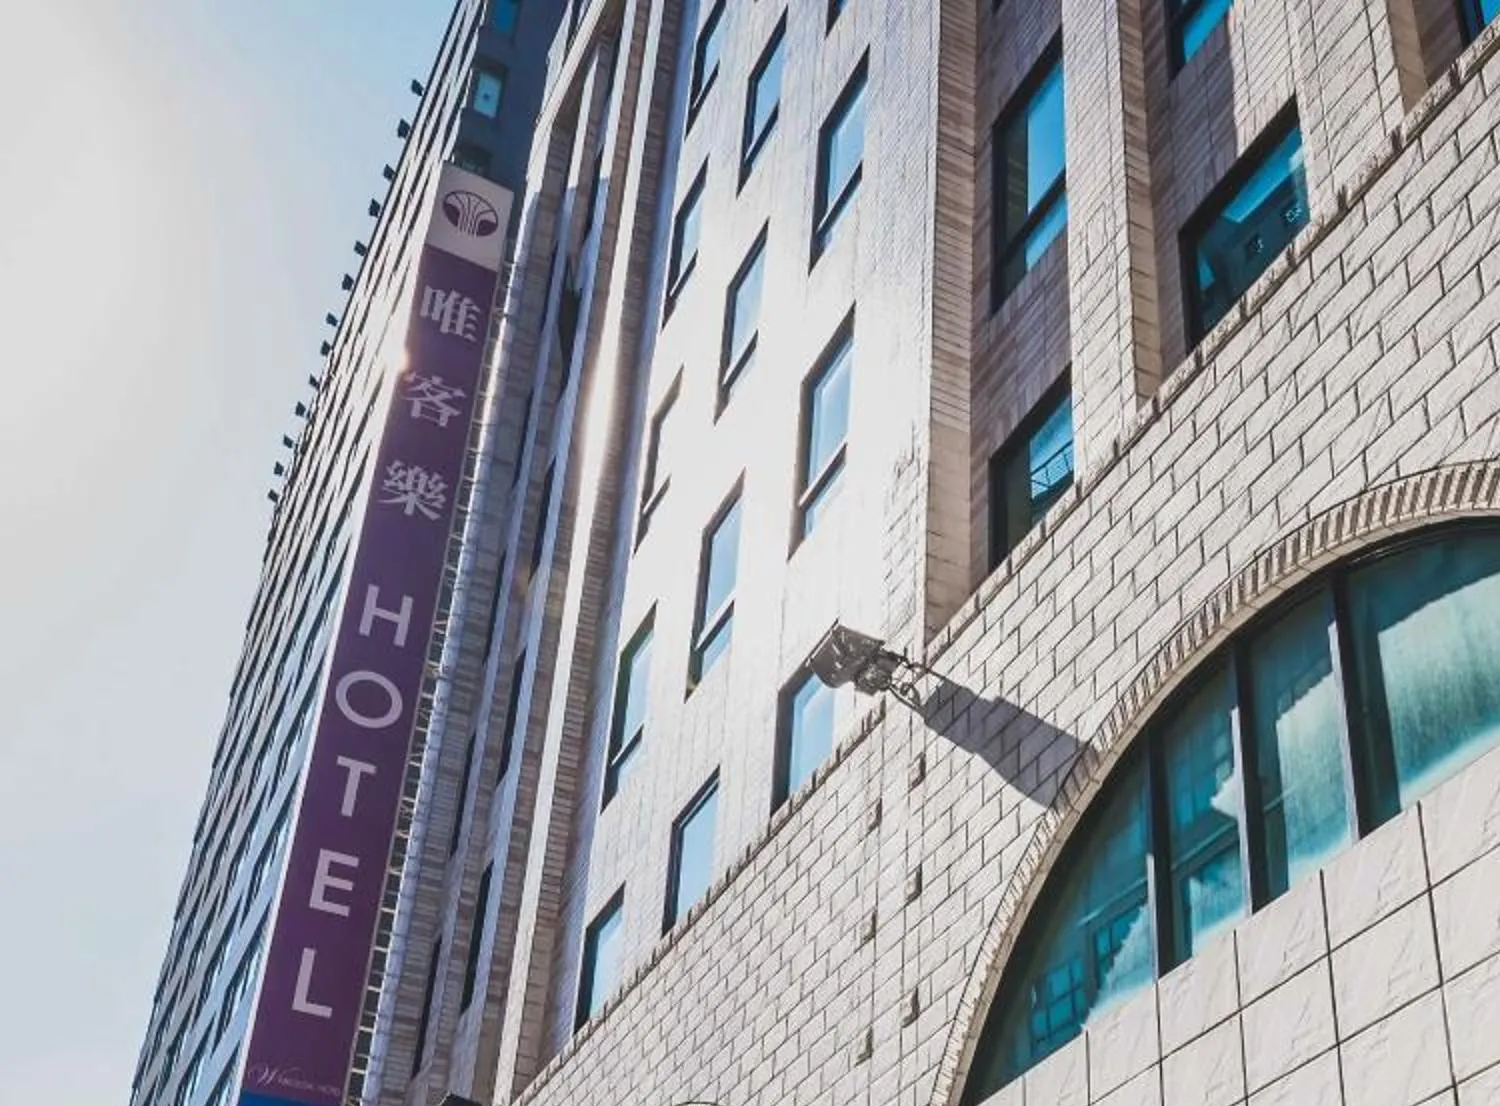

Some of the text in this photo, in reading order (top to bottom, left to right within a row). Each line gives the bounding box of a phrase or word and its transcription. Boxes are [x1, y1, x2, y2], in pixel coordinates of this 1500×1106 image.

[381, 284, 481, 521] 唯客樂
[291, 585, 414, 1018] HOTEL
